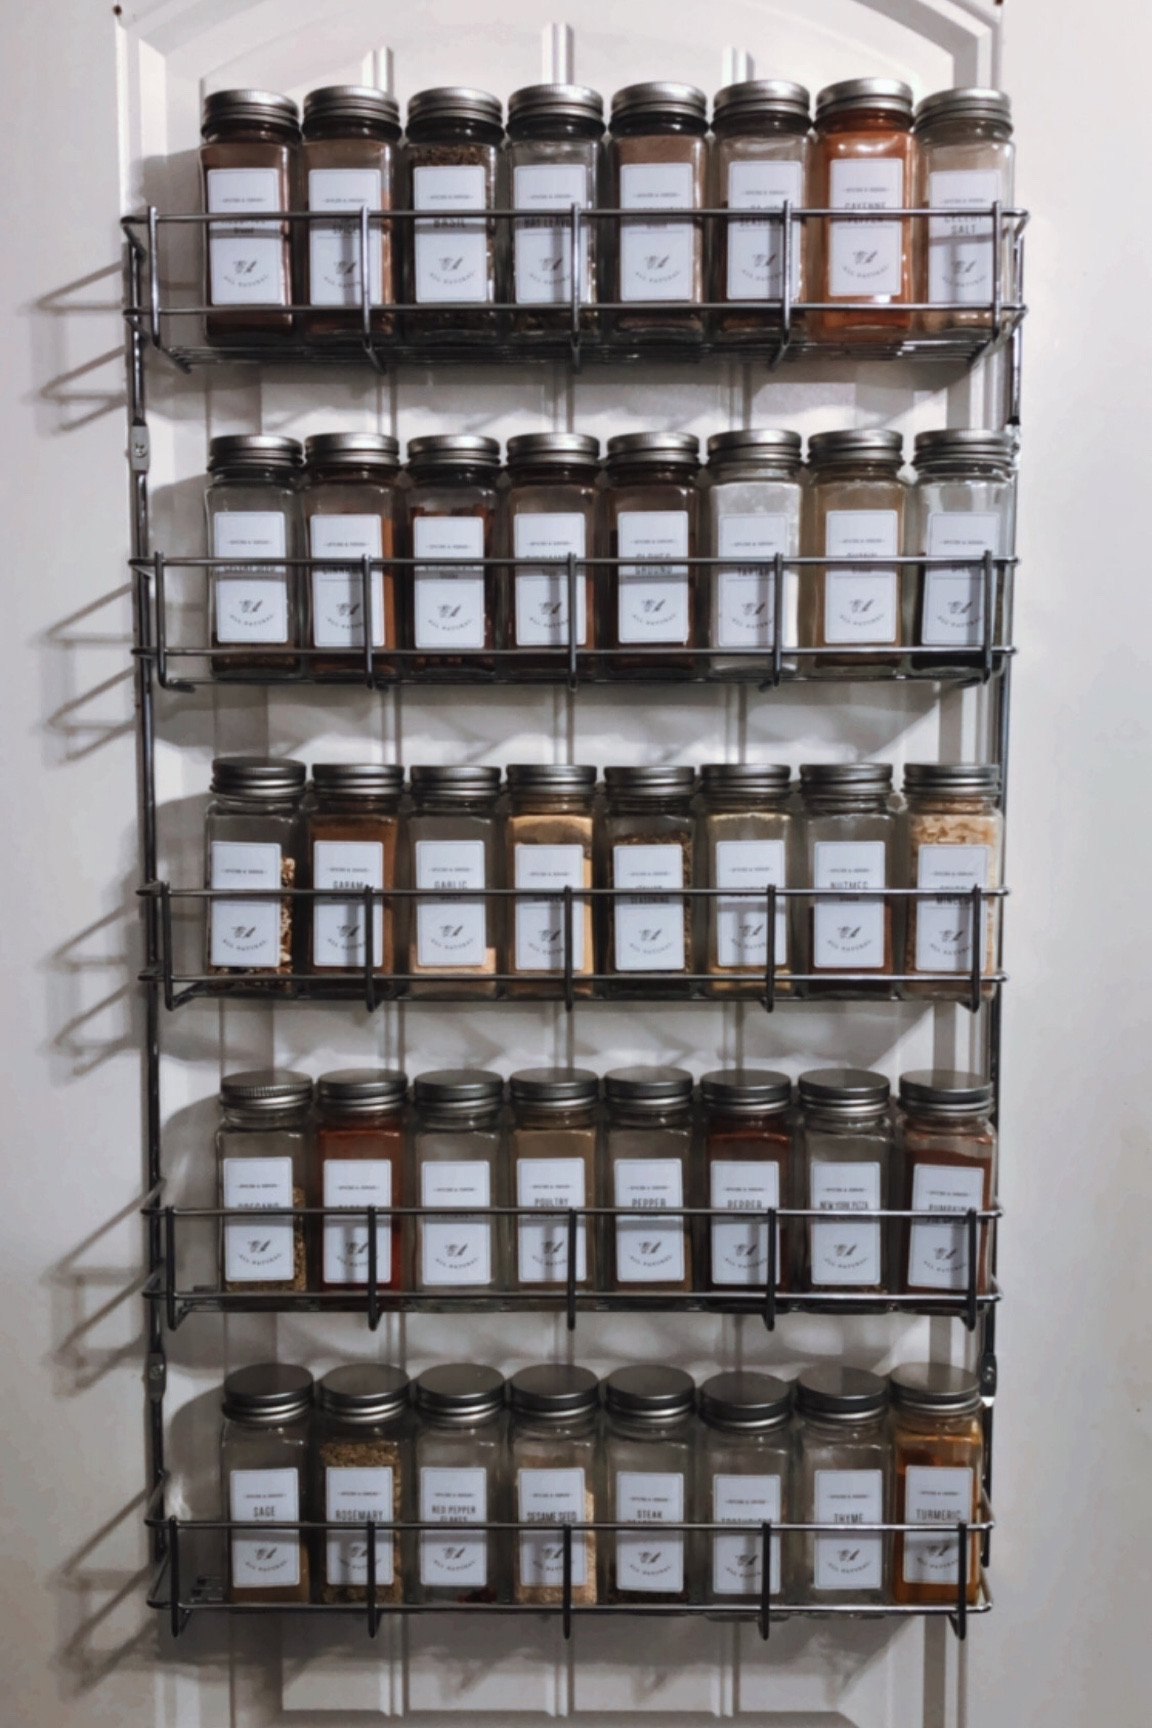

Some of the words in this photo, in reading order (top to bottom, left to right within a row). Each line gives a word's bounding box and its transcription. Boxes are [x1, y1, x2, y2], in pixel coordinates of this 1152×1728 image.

[951, 224, 977, 236] SALT
[433, 880, 469, 890] GARLIC
[534, 1197, 569, 1208] POULTRY
[631, 1197, 667, 1209] PEPPER
[252, 1505, 276, 1518] SAGE
[335, 1509, 384, 1522] ROSEMARY
[431, 1504, 447, 1515] RED
[448, 1504, 476, 1515] PEPPER
[636, 1510, 664, 1520] STEAK
[916, 1508, 961, 1521] TURMERIC
[526, 1510, 557, 1522] SESAME
[558, 1510, 578, 1522] SEED
[833, 1512, 864, 1524] THYME
